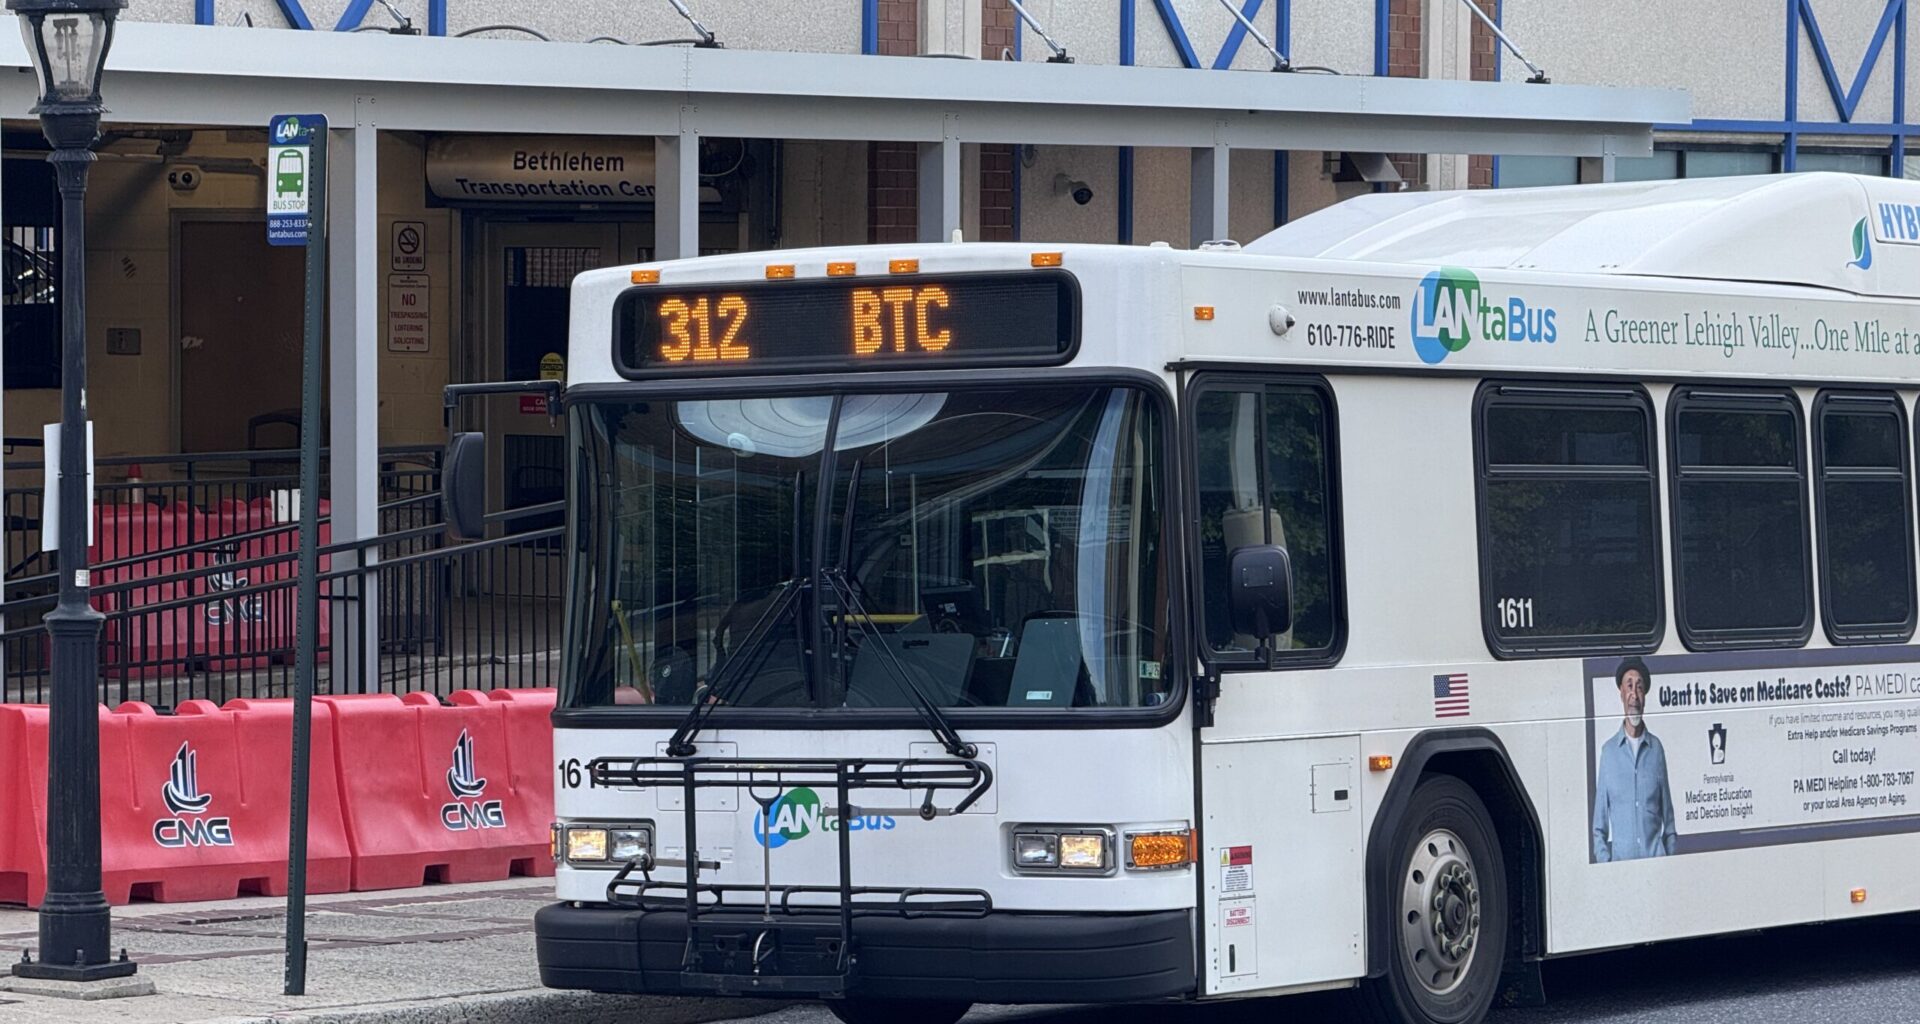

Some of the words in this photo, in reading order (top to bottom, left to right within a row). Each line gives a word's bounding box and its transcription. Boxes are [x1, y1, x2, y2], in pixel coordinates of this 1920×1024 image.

[513, 150, 624, 172] Bethlehem
[456, 178, 614, 198] Transportation
[619, 180, 656, 197] Cen
[273, 201, 287, 210] BUS
[287, 200, 306, 210] STOP
[269, 230, 308, 239] lantabus.com
[402, 293, 416, 306] NO
[1298, 287, 1401, 309] www.lantabus.com
[390, 311, 428, 319] TRESPASSING
[660, 296, 750, 361] 312
[853, 287, 951, 354] BTC
[1415, 285, 1557, 344] LANtaBus
[394, 324, 423, 332] LOITERING
[1307, 323, 1395, 349] 610-776-RIDE
[1585, 308, 1600, 343] A
[1605, 309, 1679, 345] Greener
[1684, 311, 1745, 358] Lehigh
[1854, 320, 1890, 353] Mile
[1895, 328, 1910, 355] at
[393, 336, 425, 345] SOLICITING
[1497, 598, 1534, 628] 1611
[1659, 682, 1692, 707] Want
[1695, 682, 1707, 705] to
[1709, 682, 1738, 704] Save
[1740, 686, 1754, 702] on
[1757, 677, 1813, 702] Medicare
[1815, 674, 1851, 698] Costs?
[1855, 675, 1872, 696] PA
[1875, 673, 1907, 695] MEDI
[1774, 715, 1784, 728] you
[1786, 713, 1799, 724] have
[1801, 712, 1820, 723] limited
[1821, 711, 1842, 722] income
[1843, 710, 1854, 721] and
[1882, 710, 1893, 721] you
[1894, 709, 1905, 720] may
[1788, 730, 1803, 740] Extra
[1804, 729, 1818, 741] Help
[1820, 726, 1838, 739] and/or
[1840, 725, 1866, 736] Medicare
[1867, 724, 1888, 736] Savings
[1890, 724, 1917, 735] Programs
[1832, 749, 1848, 764] Call
[1850, 747, 1876, 765] today!
[1703, 772, 1734, 785] Pennsylvania
[1793, 779, 1804, 793] PA
[1806, 778, 1826, 792] MEDI
[1828, 776, 1858, 792] Helpline
[1859, 771, 1914, 788] 1-800-783-7067
[1685, 789, 1717, 804] Medicare
[1719, 786, 1752, 801] Education
[1803, 802, 1810, 811] or
[1810, 801, 1825, 812] your
[1825, 797, 1840, 809] local
[1841, 797, 1855, 808] Area
[1856, 795, 1878, 808] Agency
[1879, 796, 1887, 805] on
[440, 800, 506, 831] CMG
[1686, 806, 1698, 820] and
[1700, 805, 1729, 819] Decision
[1731, 802, 1753, 819] Insight
[153, 816, 234, 848] CMG
